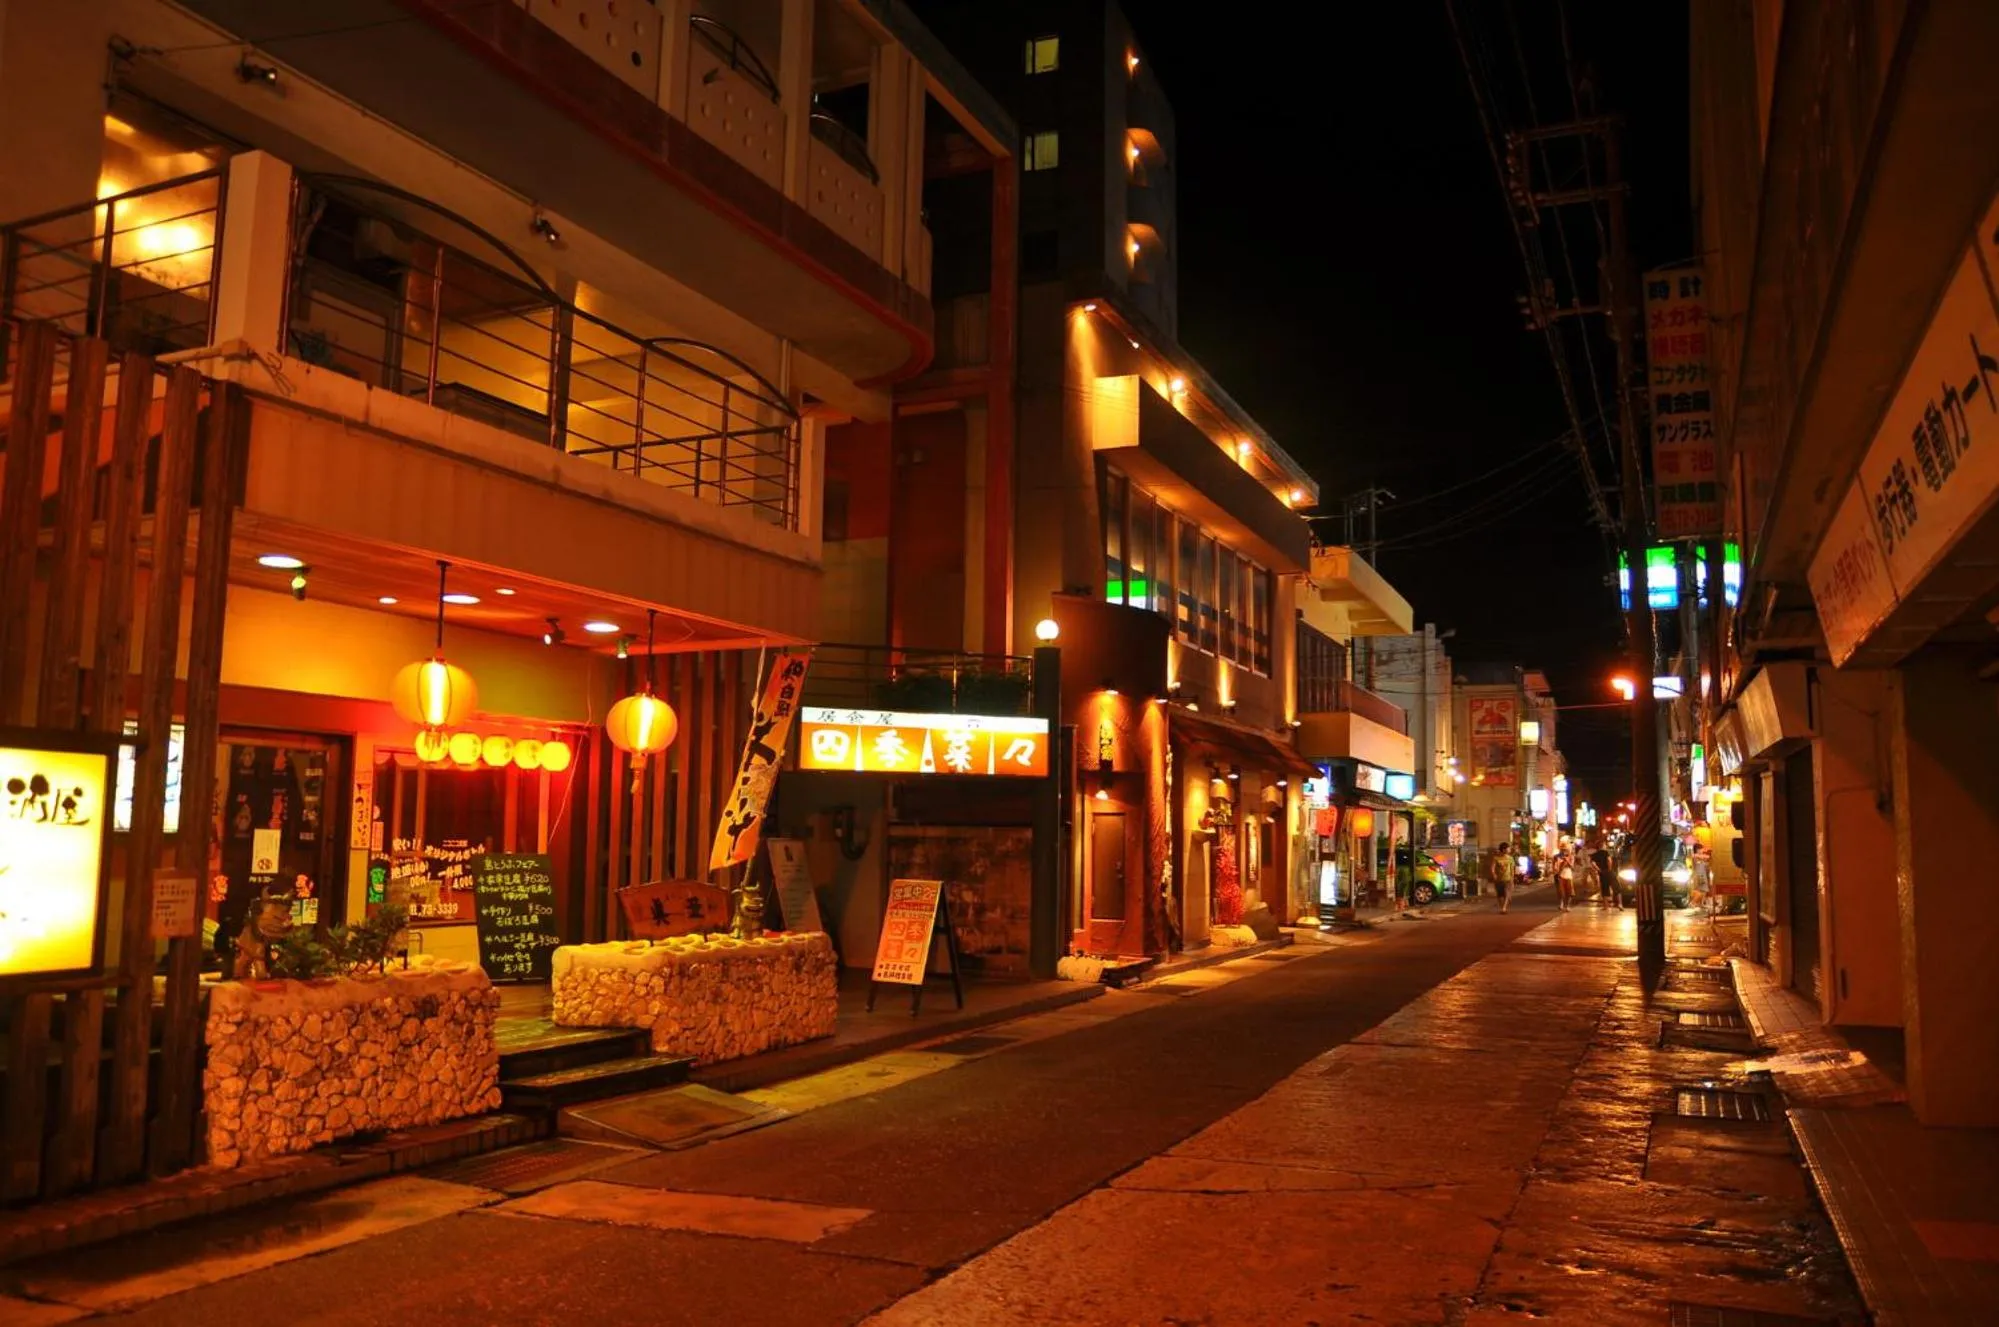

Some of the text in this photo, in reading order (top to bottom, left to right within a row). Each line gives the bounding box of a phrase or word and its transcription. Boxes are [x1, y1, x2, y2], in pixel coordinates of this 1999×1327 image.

[1649, 277, 1702, 300] 時計
[1652, 305, 1707, 330] メガネ
[1654, 361, 1709, 386] コンタクト
[1657, 420, 1714, 444] サングラス
[811, 728, 1037, 773] 四季菜々
